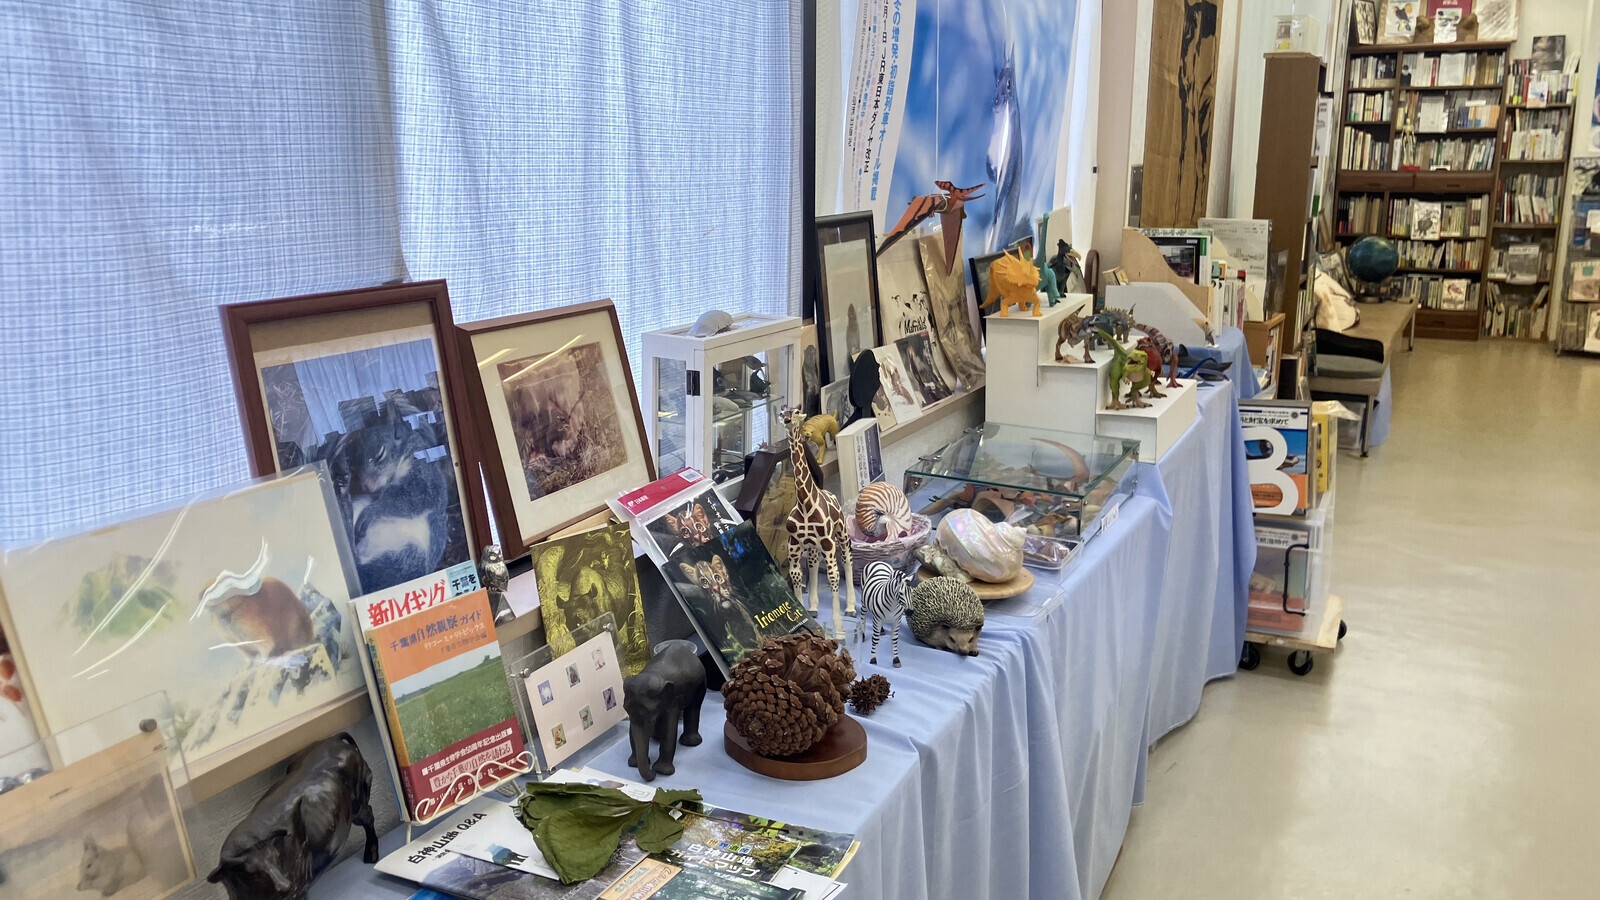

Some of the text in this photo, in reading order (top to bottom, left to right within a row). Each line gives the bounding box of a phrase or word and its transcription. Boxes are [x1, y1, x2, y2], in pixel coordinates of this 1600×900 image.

[367, 579, 446, 628] 新ハイキング
[754, 601, 792, 629] Iriomote
[786, 609, 803, 622] Cat
[407, 830, 460, 864] 白神山地
[456, 812, 488, 831] Q&A
[670, 848, 761, 877] ガイドマップ
[687, 843, 756, 866] 白神山地
